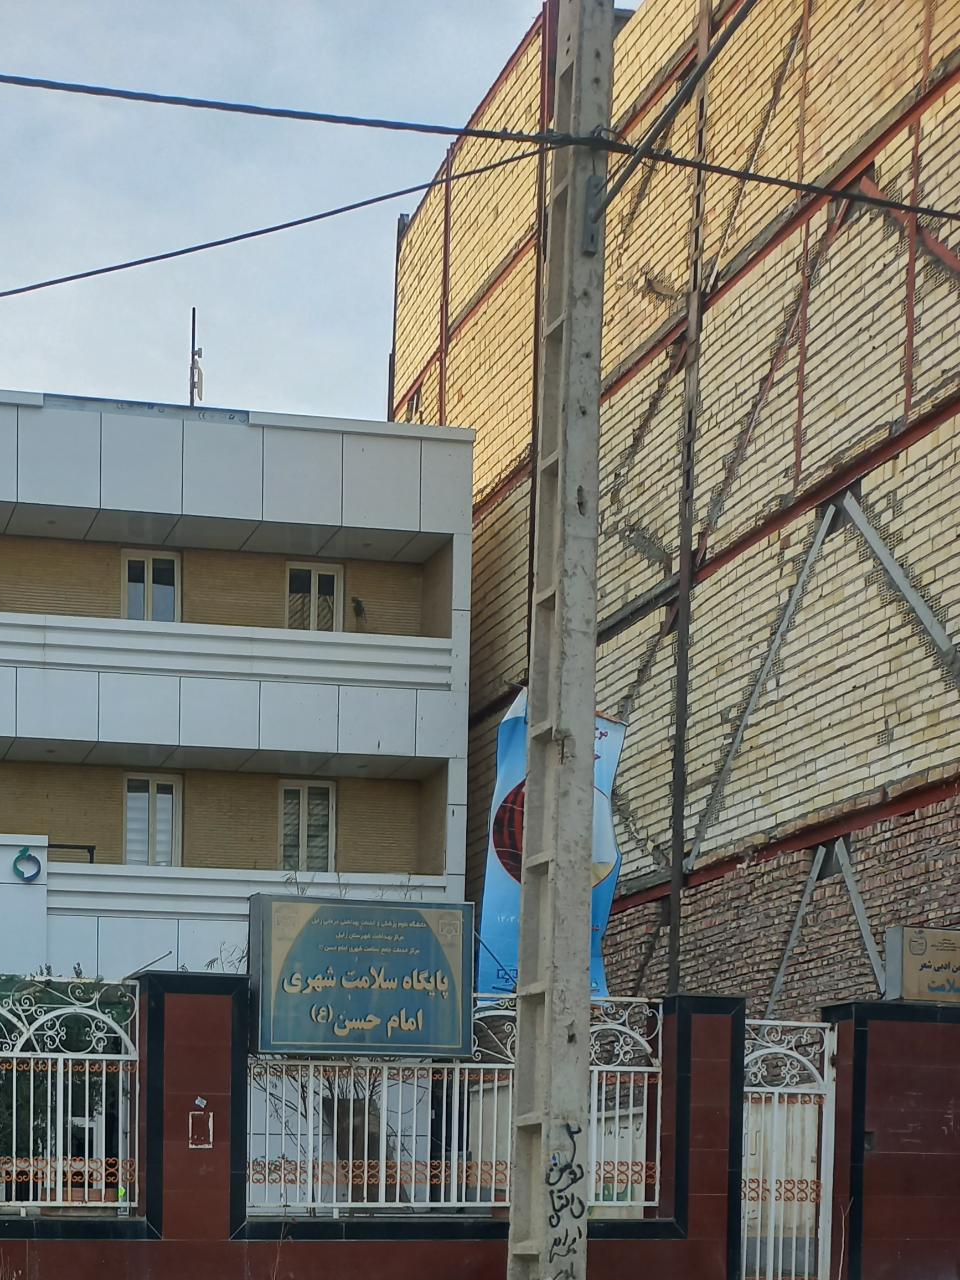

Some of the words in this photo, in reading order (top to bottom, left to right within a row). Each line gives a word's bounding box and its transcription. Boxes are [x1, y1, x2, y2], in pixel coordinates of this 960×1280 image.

[282, 965, 337, 995] شهری
[341, 965, 398, 991] سلامت
[402, 968, 449, 999] پایگاه
[386, 1007, 424, 1039] امام
